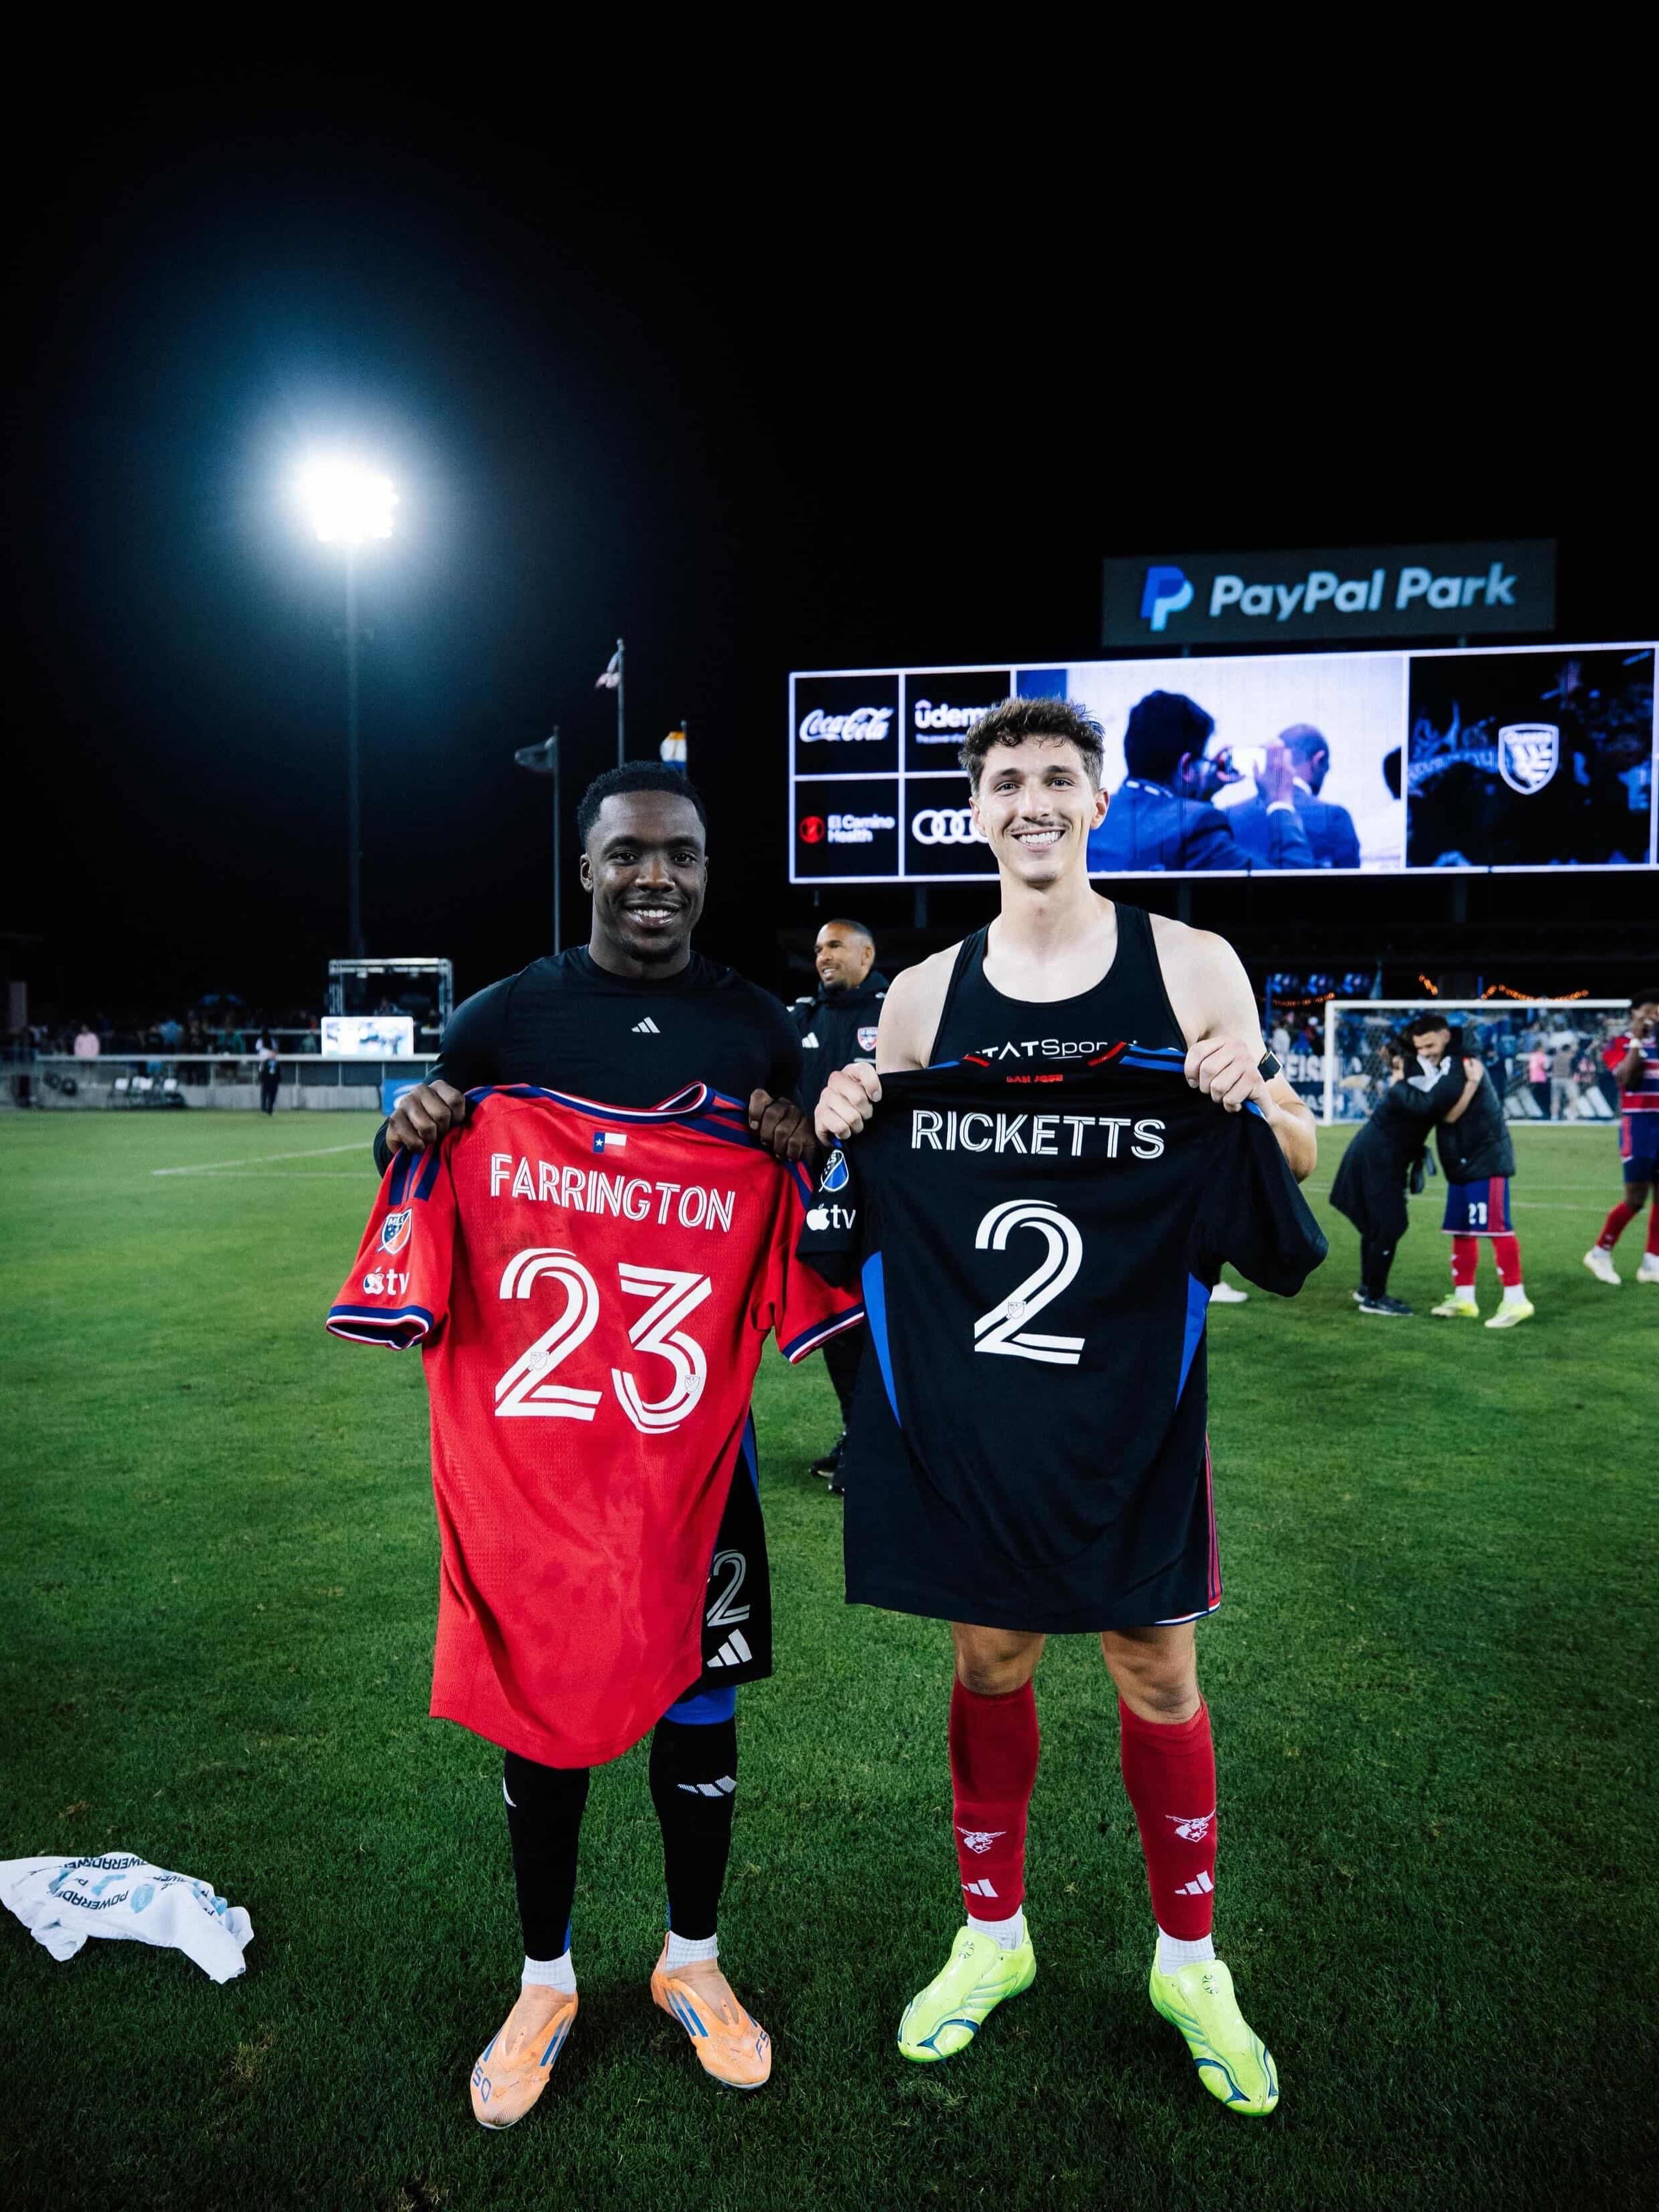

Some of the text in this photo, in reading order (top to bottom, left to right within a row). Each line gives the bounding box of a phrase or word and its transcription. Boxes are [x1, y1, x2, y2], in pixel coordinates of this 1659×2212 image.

[1210, 569, 1386, 622] PayPal
[1397, 562, 1518, 610] Park
[911, 1110, 1166, 1159] RICKETTS
[490, 1153, 736, 1233] FARRINGTON
[830, 1204, 857, 1229] tv
[386, 1268, 410, 1296] tv
[974, 1199, 1085, 1365] 2
[495, 1247, 712, 1434] 23
[706, 1549, 751, 1627] 2
